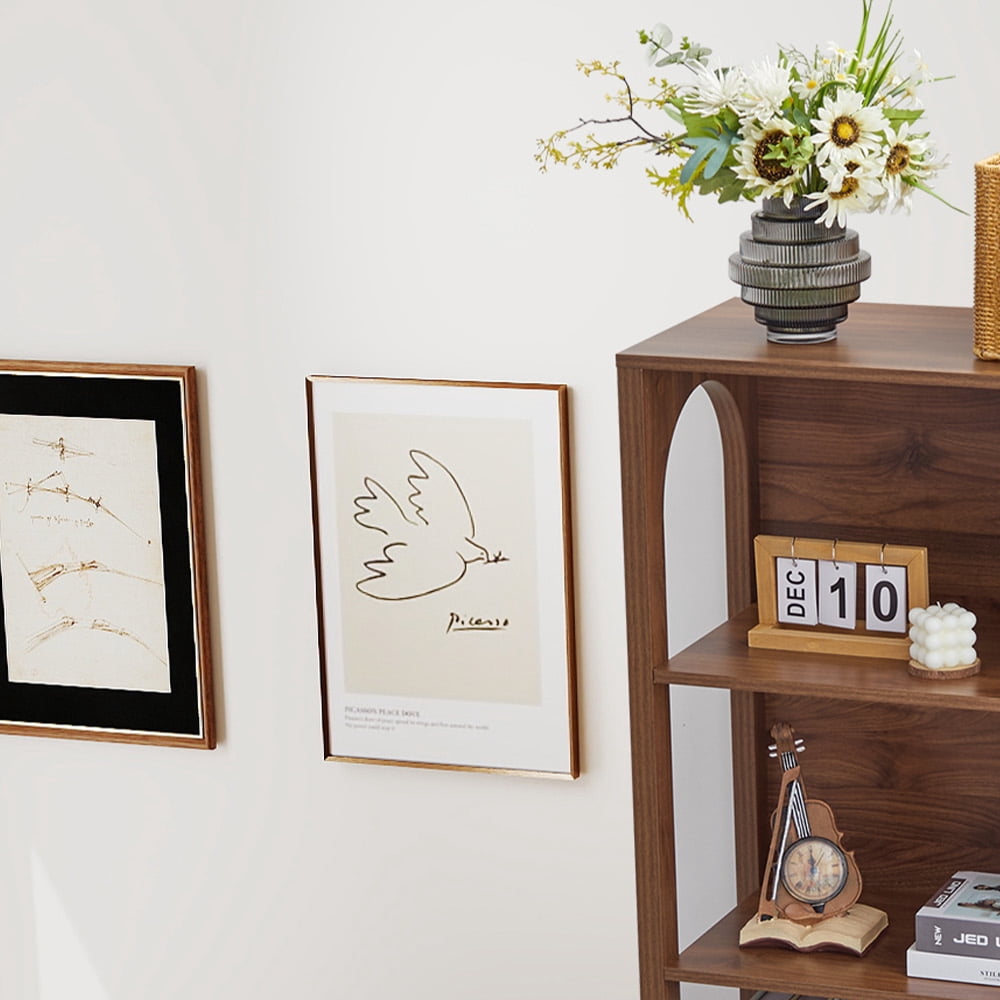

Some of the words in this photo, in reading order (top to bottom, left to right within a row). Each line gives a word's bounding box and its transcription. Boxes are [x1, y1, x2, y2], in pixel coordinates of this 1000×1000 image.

[785, 570, 806, 618] DEC
[933, 925, 943, 946] NEW
[952, 932, 989, 947] JED
